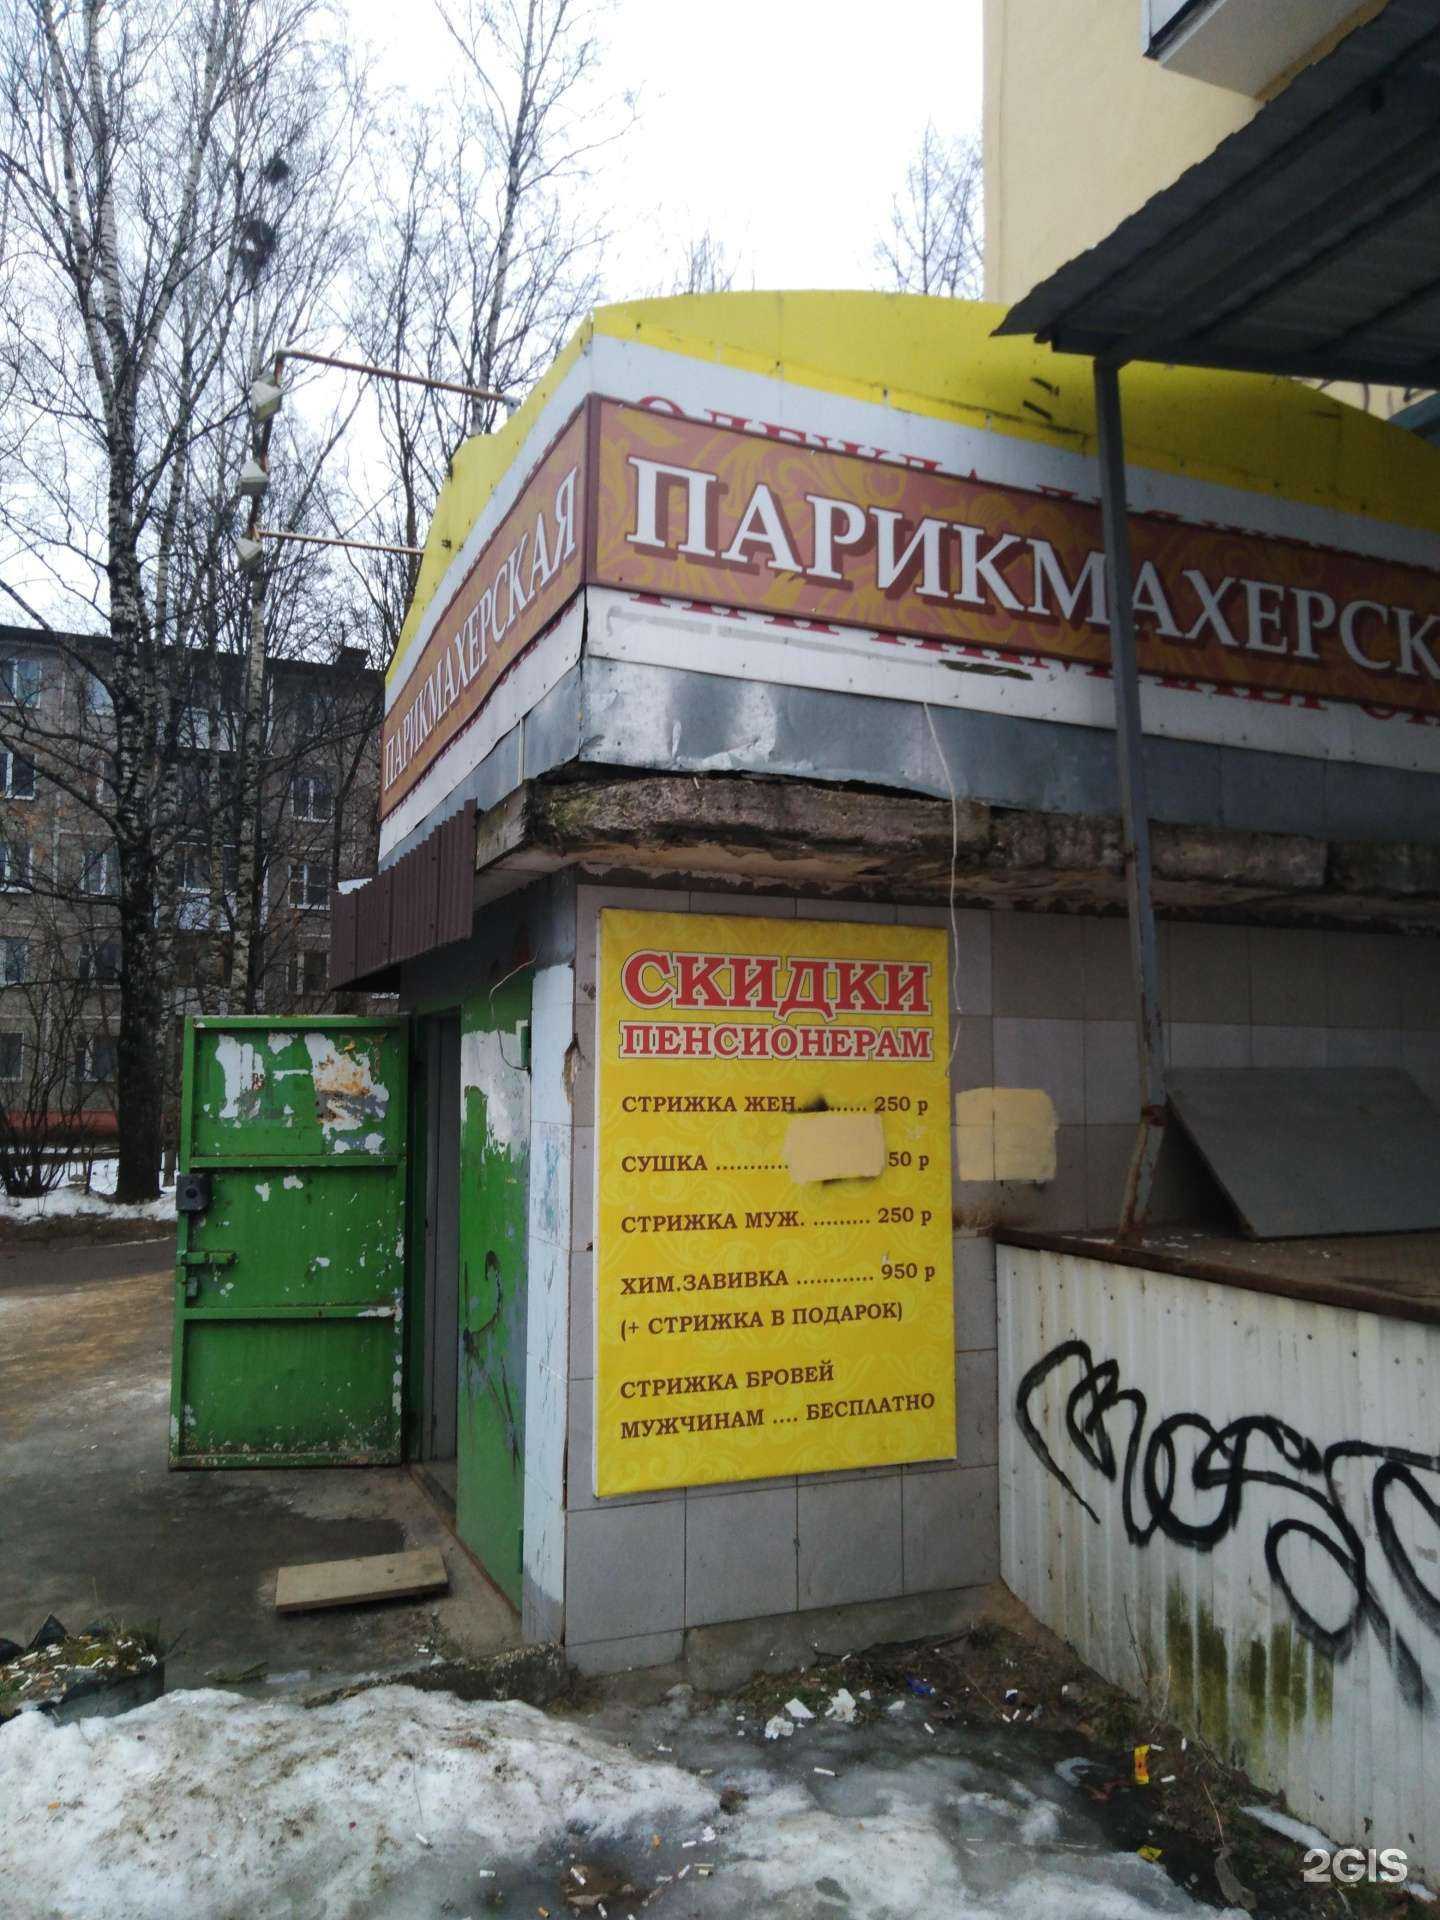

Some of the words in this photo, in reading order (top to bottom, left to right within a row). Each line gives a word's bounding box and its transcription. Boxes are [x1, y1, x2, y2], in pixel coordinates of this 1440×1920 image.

[383, 466, 577, 790] ПАРИКМАХЕРСКАЯ
[622, 951, 932, 1022] СКИДКИ
[620, 1022, 933, 1059] ПЕНСИОНЕРАМ
[621, 1095, 737, 1113] СТРИЖКА
[874, 1096, 911, 1113] 250
[621, 1153, 708, 1173] СУШКА
[620, 1212, 737, 1234] СТРИЖКА
[877, 1206, 914, 1224] 250
[880, 1263, 918, 1281] 950
[648, 1311, 764, 1336] СТРИЖКА
[771, 1309, 785, 1326] В
[792, 1301, 904, 1326] ПОДАРОК)
[620, 1374, 737, 1399] СТРИЖКА
[746, 1360, 834, 1388] БРОВЕЙ
[620, 1409, 764, 1440] МУЖЧИНАМ
[806, 1392, 935, 1421] БЕСПЛАТНО
